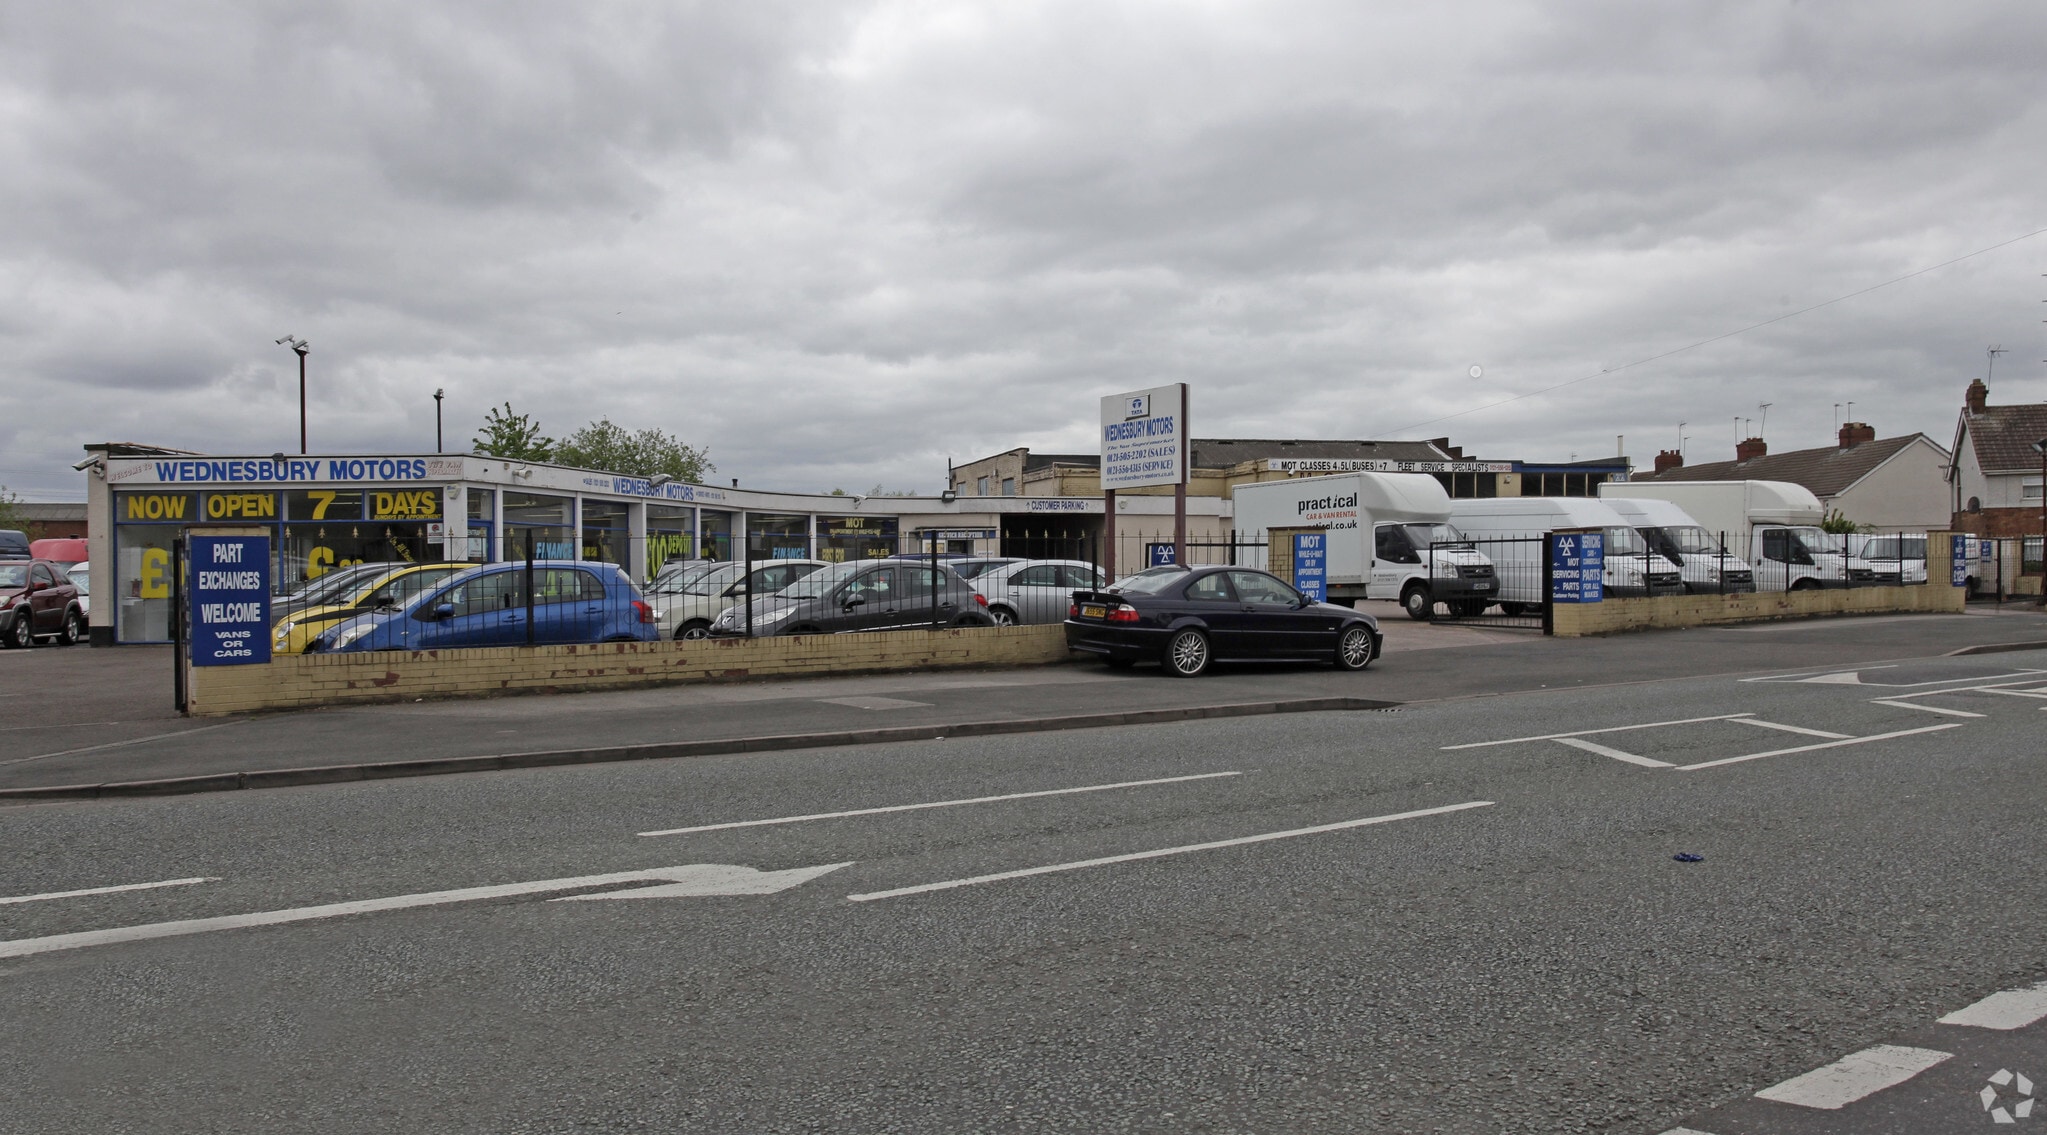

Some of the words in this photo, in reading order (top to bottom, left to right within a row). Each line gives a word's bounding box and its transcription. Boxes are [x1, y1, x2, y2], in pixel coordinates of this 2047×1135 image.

[1104, 420, 1146, 442] WEDNESBURY
[1146, 416, 1174, 436] MOTORS
[1131, 438, 1174, 448] Supermarket
[1106, 448, 1147, 462] 0121-505-2202
[1148, 445, 1176, 458] (SALES)
[155, 460, 321, 482] WEDNESBURY
[330, 459, 426, 480] MOTORS
[428, 460, 444, 469] THE
[1142, 459, 1174, 472] (SERVICE)
[1281, 461, 1297, 470] MOT
[1300, 461, 1331, 470] CLASSES
[1379, 462, 1388, 470] +7
[1398, 462, 1416, 471] FLEET
[1420, 462, 1444, 472] SERVICE
[1452, 462, 1488, 472] SPECIALISTS
[110, 464, 142, 482] WELCOME
[612, 477, 665, 498] WEDNESBURY
[666, 484, 694, 501] MOTORS
[128, 496, 186, 519] NOW
[208, 494, 274, 518] OPEN
[308, 491, 336, 520] 7
[376, 491, 436, 515] DAYS
[1031, 500, 1061, 510] CUSTOMER
[1062, 501, 1085, 510] PARKING
[1298, 492, 1358, 515] practical
[1336, 510, 1357, 518] RENTAL
[846, 518, 865, 528] MOT
[668, 535, 692, 554] DEPOSIT
[1300, 536, 1320, 548] MOT
[1582, 535, 1600, 548] SERVICING
[213, 544, 244, 563] PART
[536, 542, 574, 560] FINANCE
[772, 548, 806, 559] FINANCE
[1567, 558, 1579, 566] MOT
[199, 572, 260, 590] EXCHANGES
[1553, 570, 1580, 579] SERVICING
[1582, 569, 1600, 581] PARTS
[1563, 582, 1580, 590] PARTS
[201, 602, 261, 624] WELCOME
[214, 649, 252, 658] CARS
